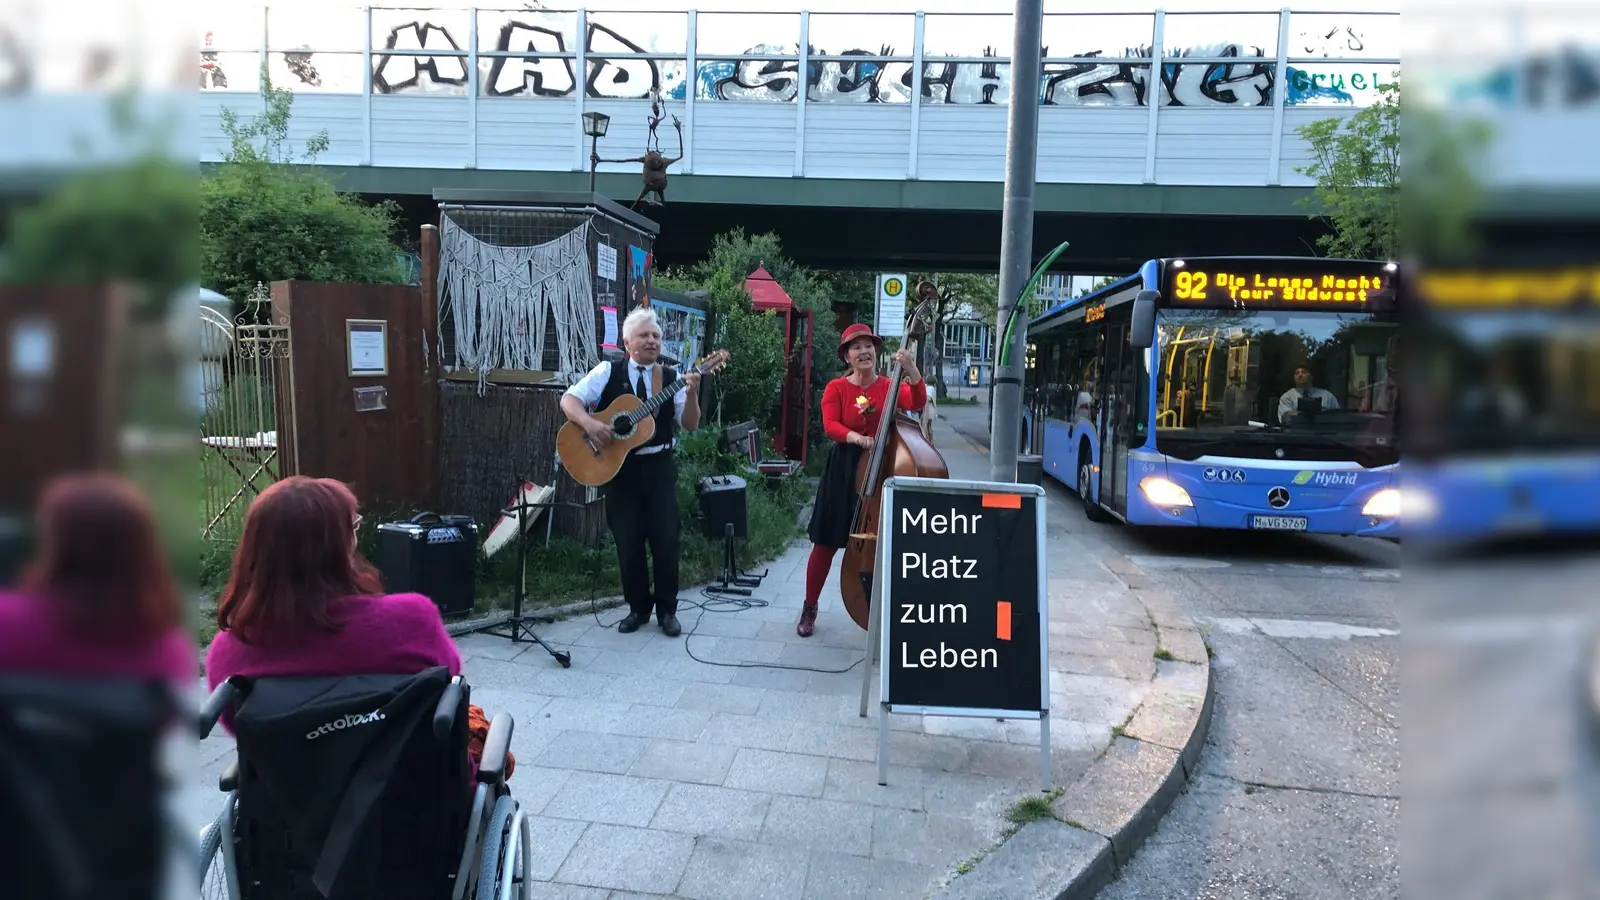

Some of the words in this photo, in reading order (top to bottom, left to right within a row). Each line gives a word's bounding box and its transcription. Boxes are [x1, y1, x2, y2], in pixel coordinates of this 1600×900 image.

[373, 20, 660, 98] MAD
[889, 281, 898, 293] H
[1176, 271, 1207, 299] 92
[1216, 273, 1246, 287] Die
[1255, 274, 1313, 289] Lange
[1322, 275, 1381, 290] Nacht
[1229, 286, 1273, 300] Tour
[1314, 472, 1358, 486] Hybrid
[902, 508, 982, 534] Mehr
[902, 553, 978, 578] Platz
[901, 603, 967, 624] zum
[902, 642, 998, 668] Leben
